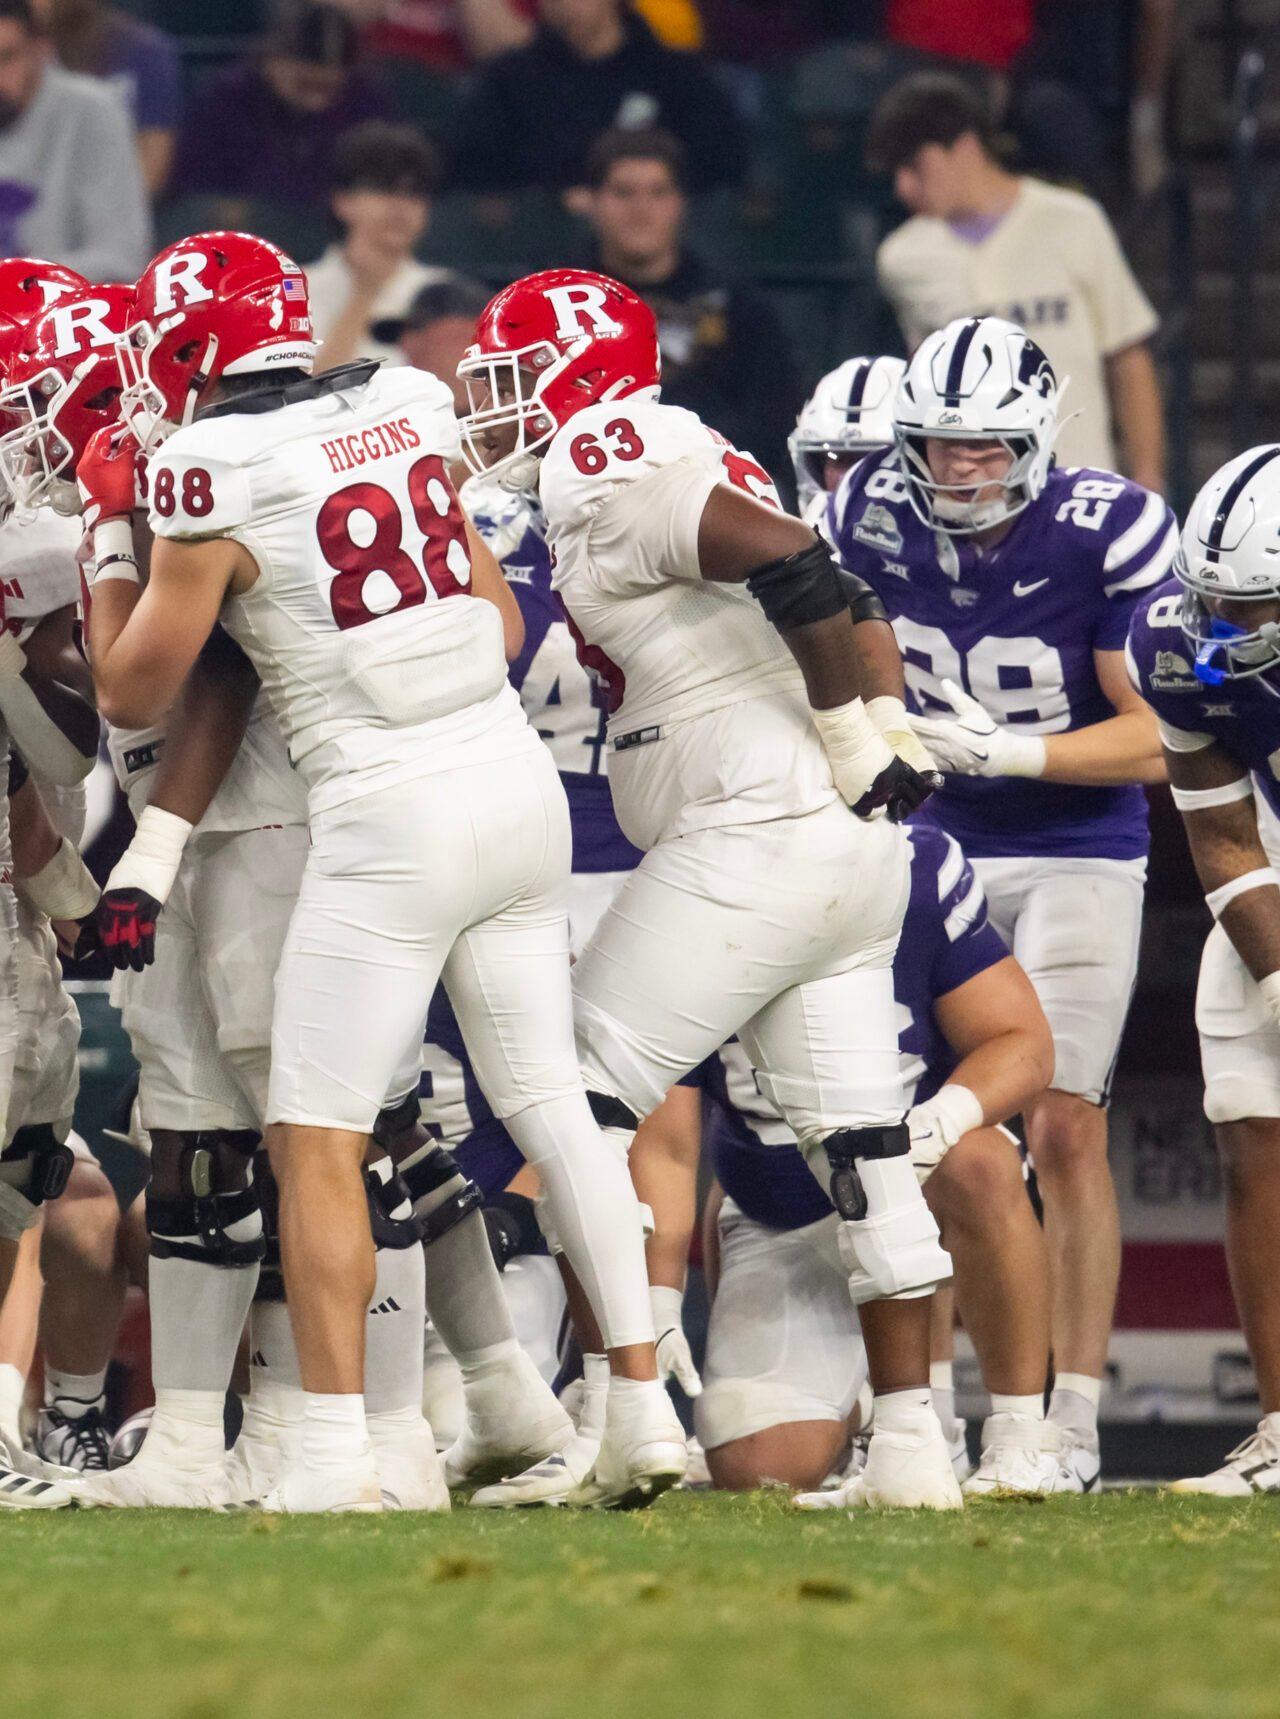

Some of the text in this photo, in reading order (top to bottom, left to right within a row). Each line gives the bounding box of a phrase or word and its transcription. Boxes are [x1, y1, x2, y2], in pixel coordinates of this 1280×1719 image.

[154, 252, 214, 316] R
[543, 284, 623, 340] R
[54, 298, 123, 358] R
[320, 417, 421, 474] HIGGINS
[570, 418, 644, 475] 63
[154, 467, 214, 518] 88
[1055, 478, 1125, 532] 28
[317, 454, 472, 631] 88
